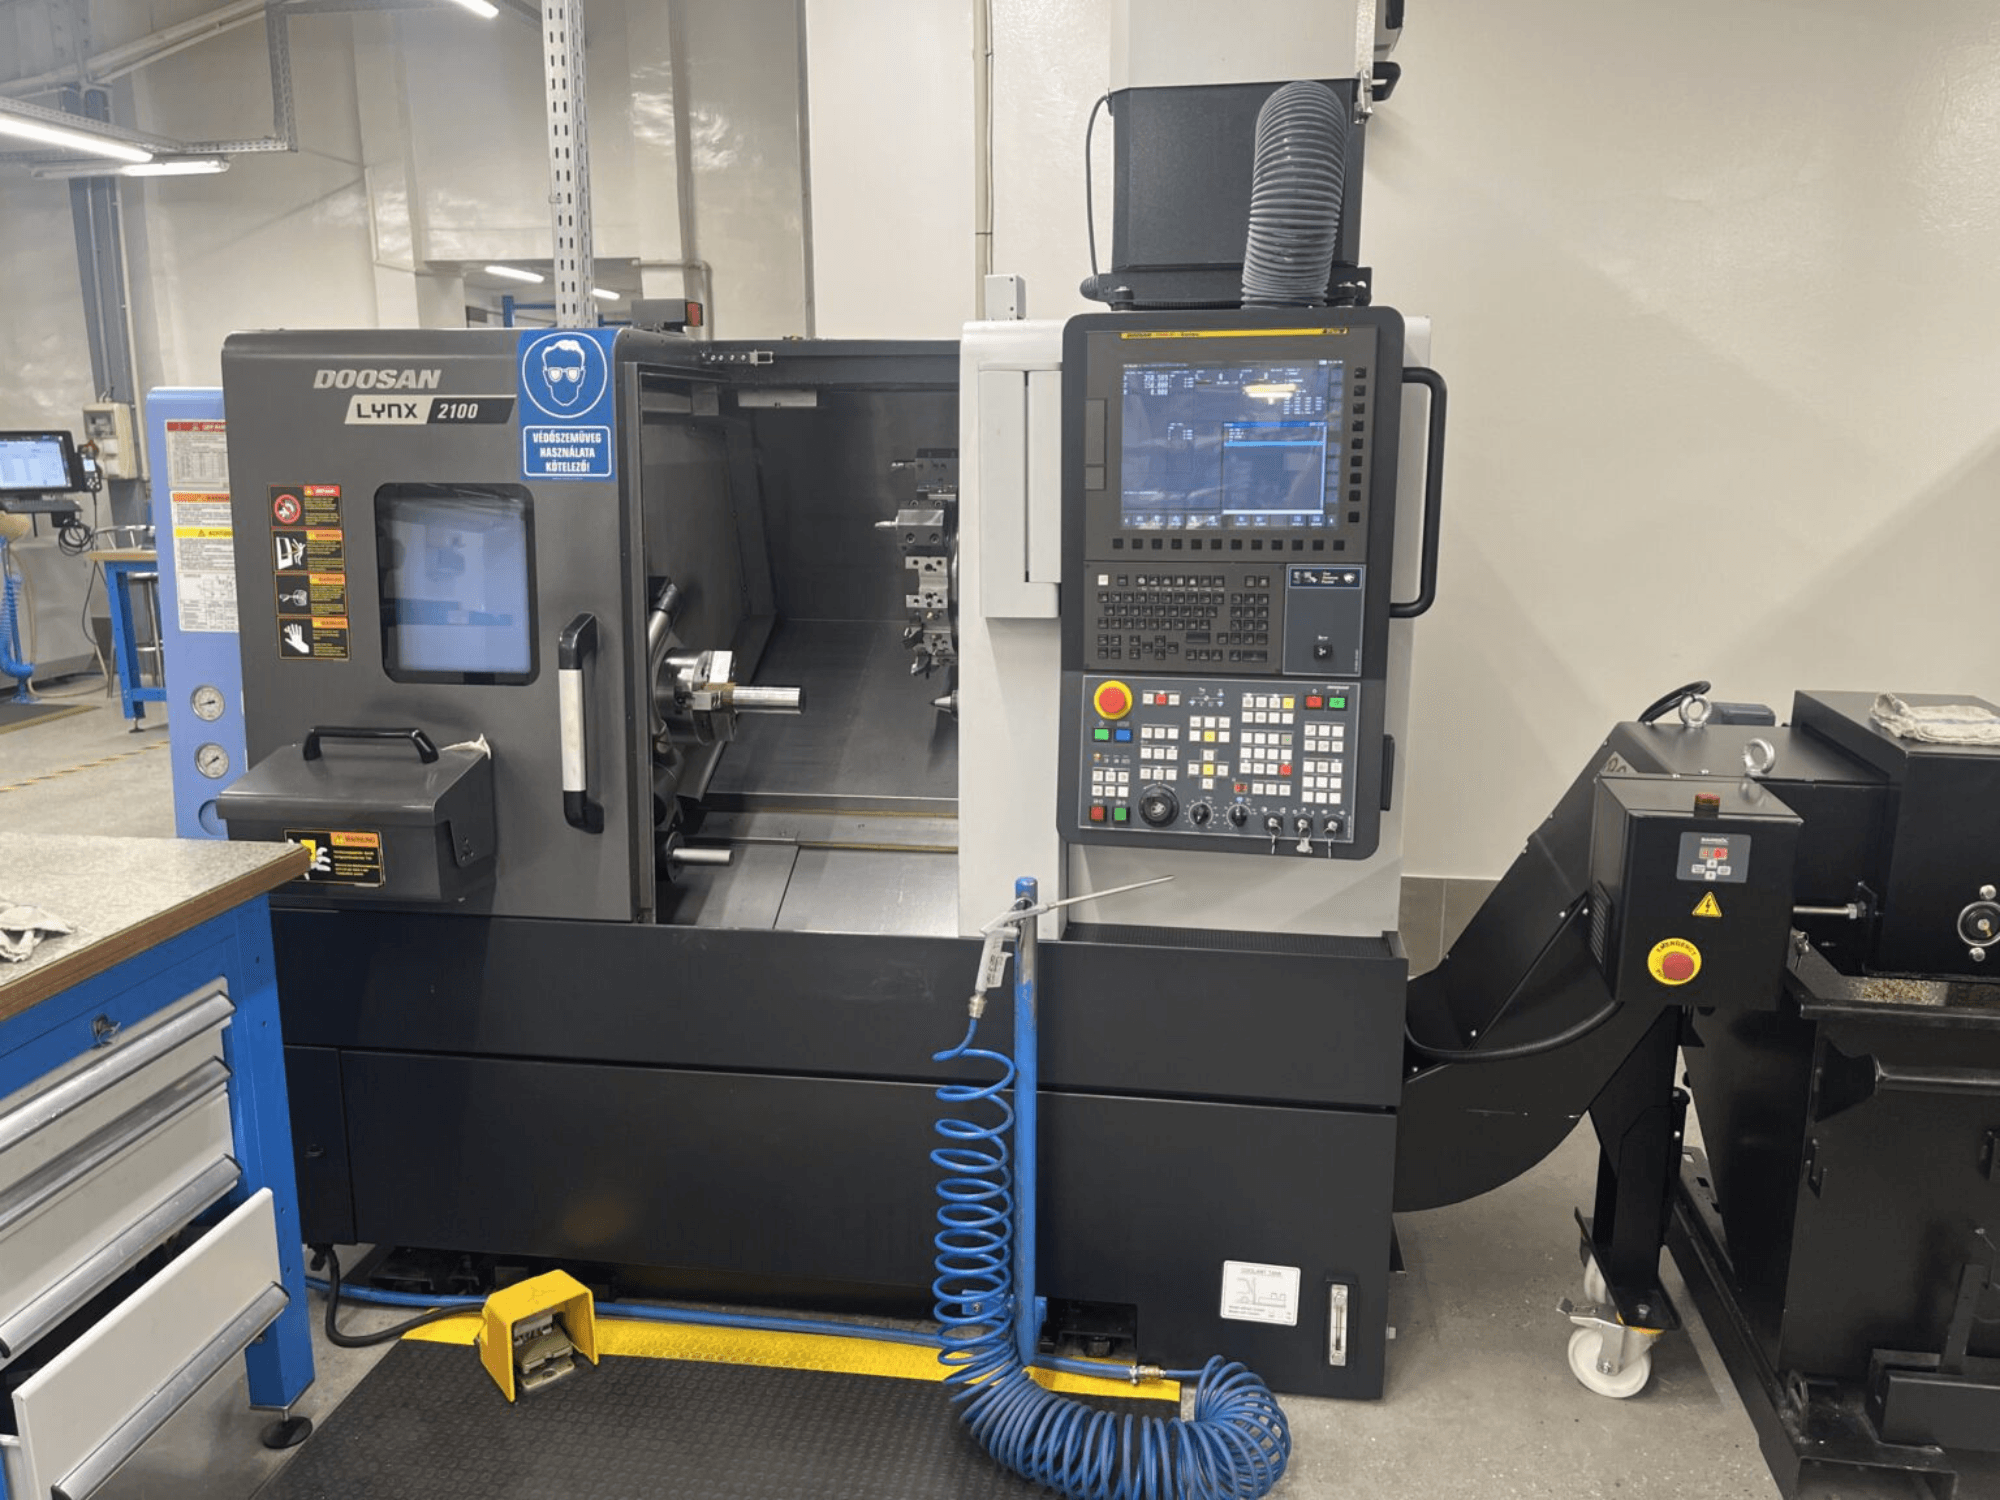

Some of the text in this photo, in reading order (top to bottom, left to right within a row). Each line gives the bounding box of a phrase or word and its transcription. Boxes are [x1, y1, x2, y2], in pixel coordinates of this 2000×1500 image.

[313, 369, 442, 389] DOOSAN
[437, 403, 479, 419] 2100
[533, 430, 602, 443] VÉDŐSZEMŰVEG
[540, 445, 596, 458] HASZNÁLATA
[545, 459, 591, 472] KÖTELEZŐ!
